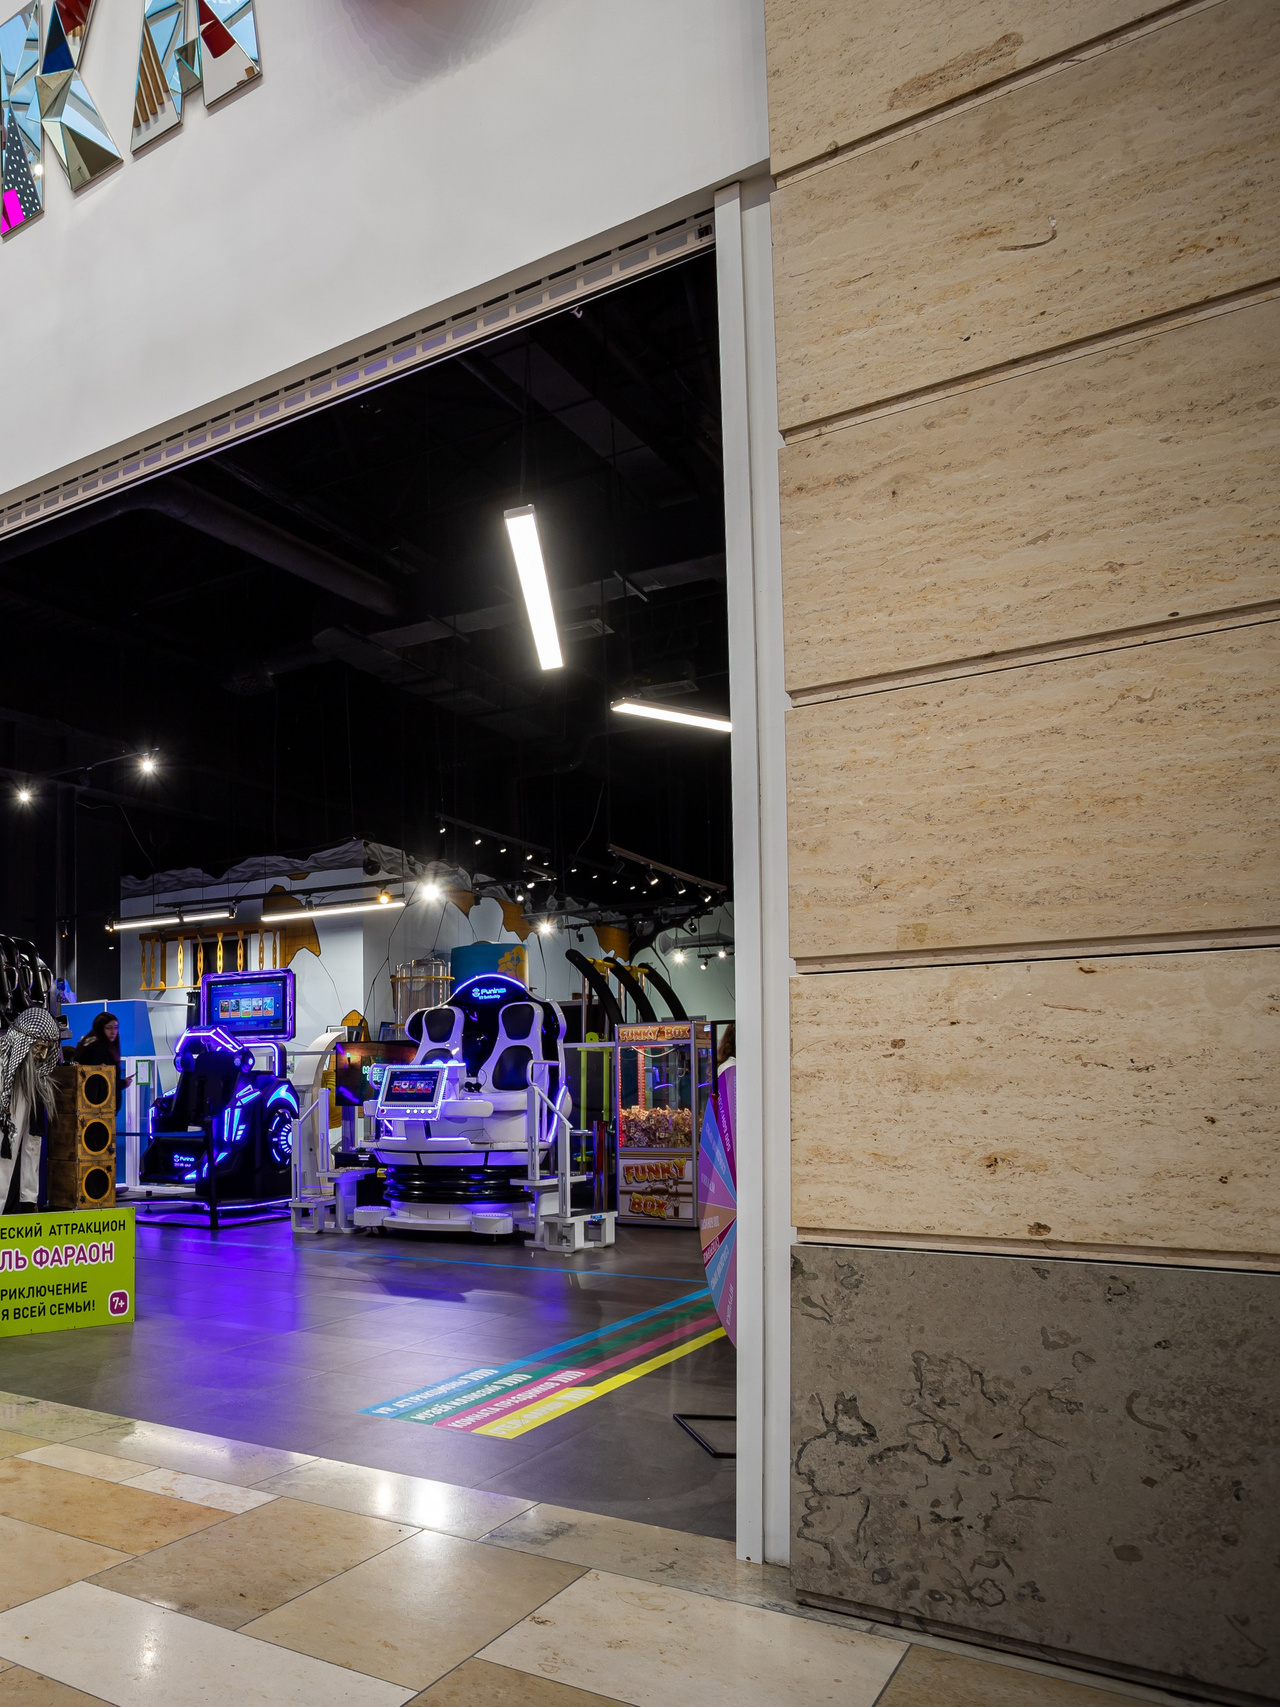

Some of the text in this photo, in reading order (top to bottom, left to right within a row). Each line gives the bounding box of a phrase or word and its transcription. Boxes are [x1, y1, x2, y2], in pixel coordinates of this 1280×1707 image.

[621, 1025, 690, 1041] FUNKY BOX
[623, 1158, 687, 1184] FUNKY
[629, 1192, 668, 1218] BOX
[49, 1219, 126, 1237] АТТРАКЦИОН
[32, 1240, 115, 1269] ФАРАОН
[13, 1302, 46, 1320] ВСЕЙ
[49, 1299, 95, 1316] СЕМЬИ!
[112, 1296, 126, 1310] 7+
[410, 1403, 457, 1421] МУЗЕЙ
[447, 1406, 505, 1429] КОМНАТА
